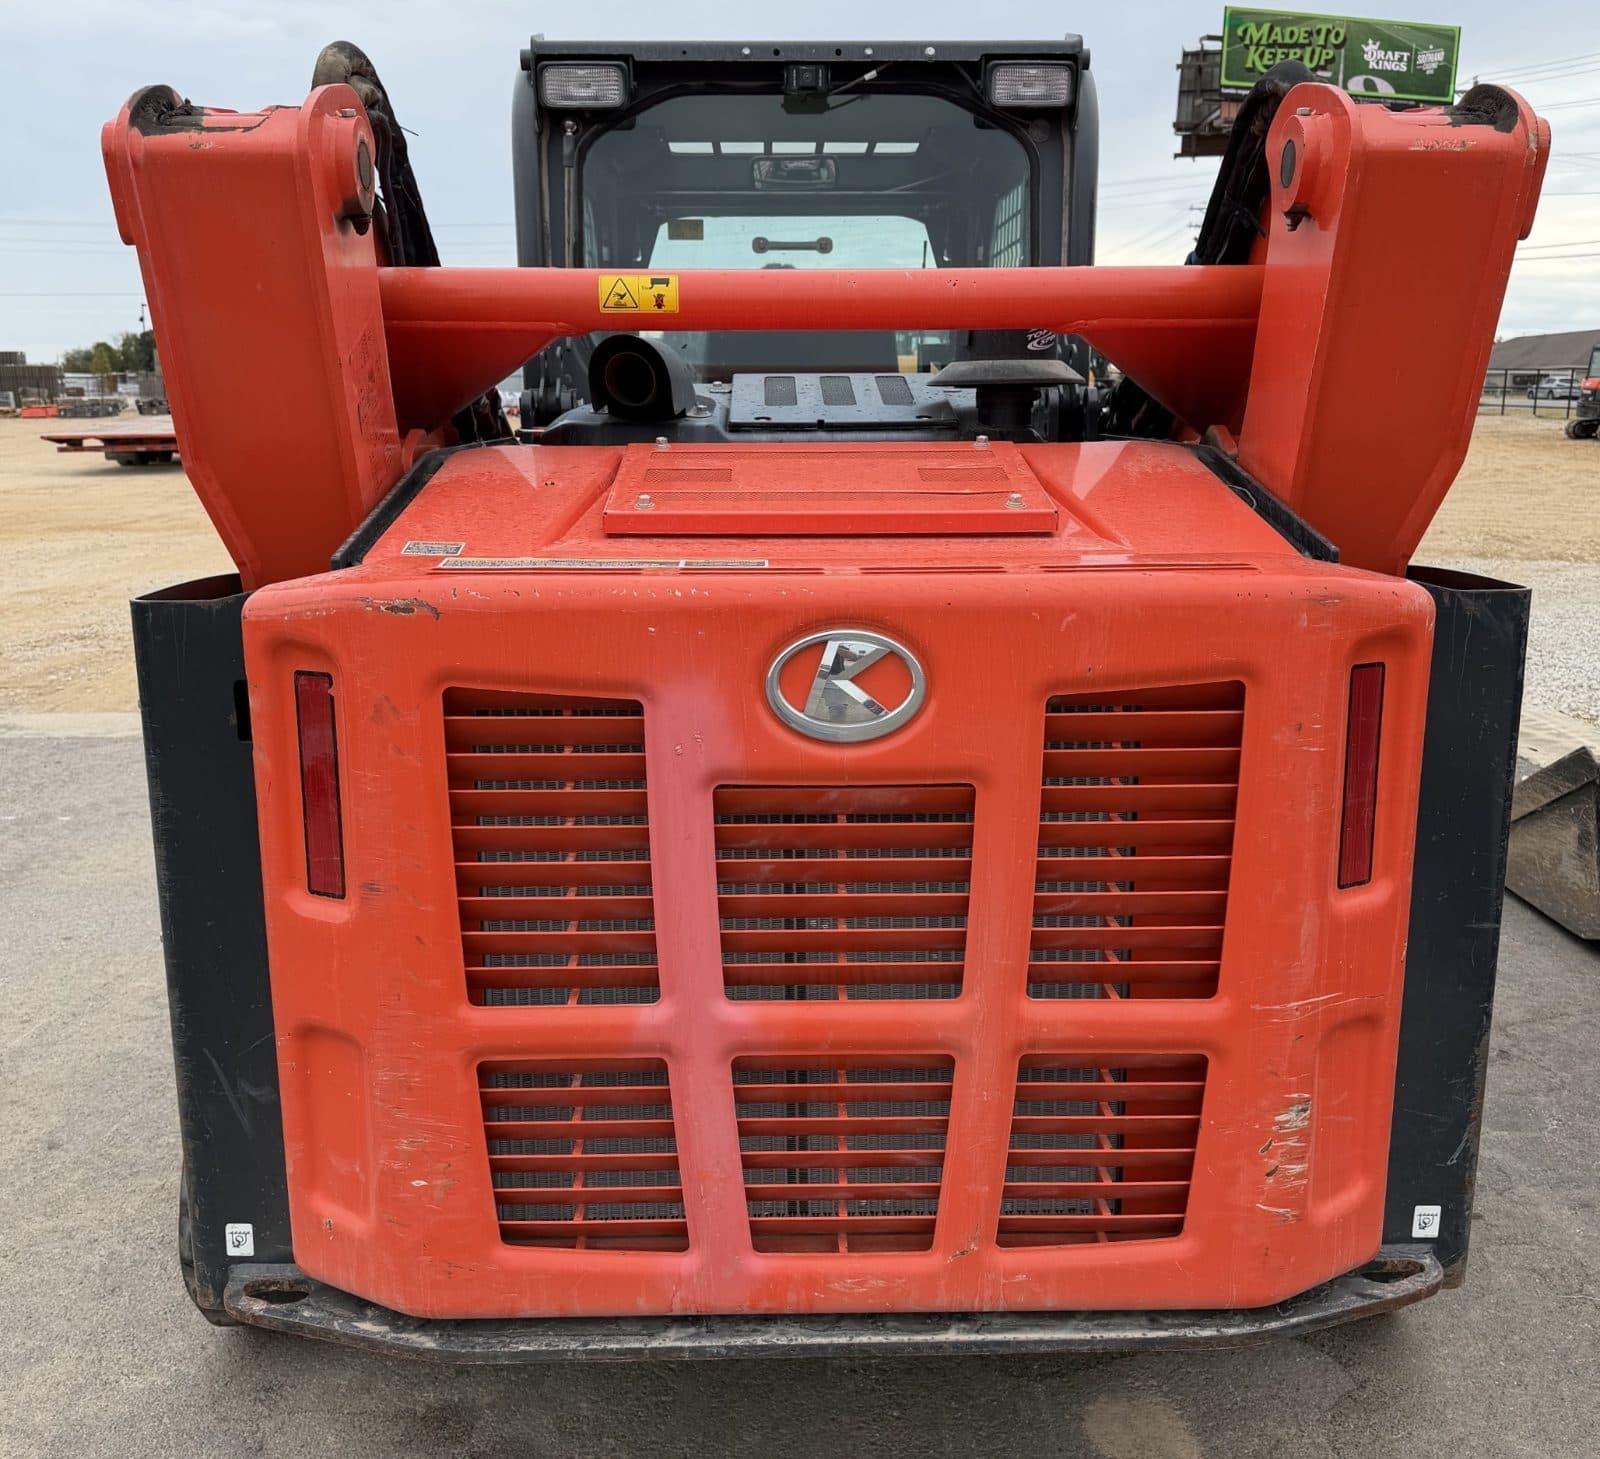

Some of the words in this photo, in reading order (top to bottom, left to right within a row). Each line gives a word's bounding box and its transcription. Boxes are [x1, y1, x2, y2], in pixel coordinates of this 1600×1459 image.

[1237, 22, 1312, 46] MADE
[1315, 23, 1345, 45] TO
[1303, 46, 1335, 69] UP
[1363, 49, 1410, 62] DRAFT
[1368, 60, 1408, 72] KINGS
